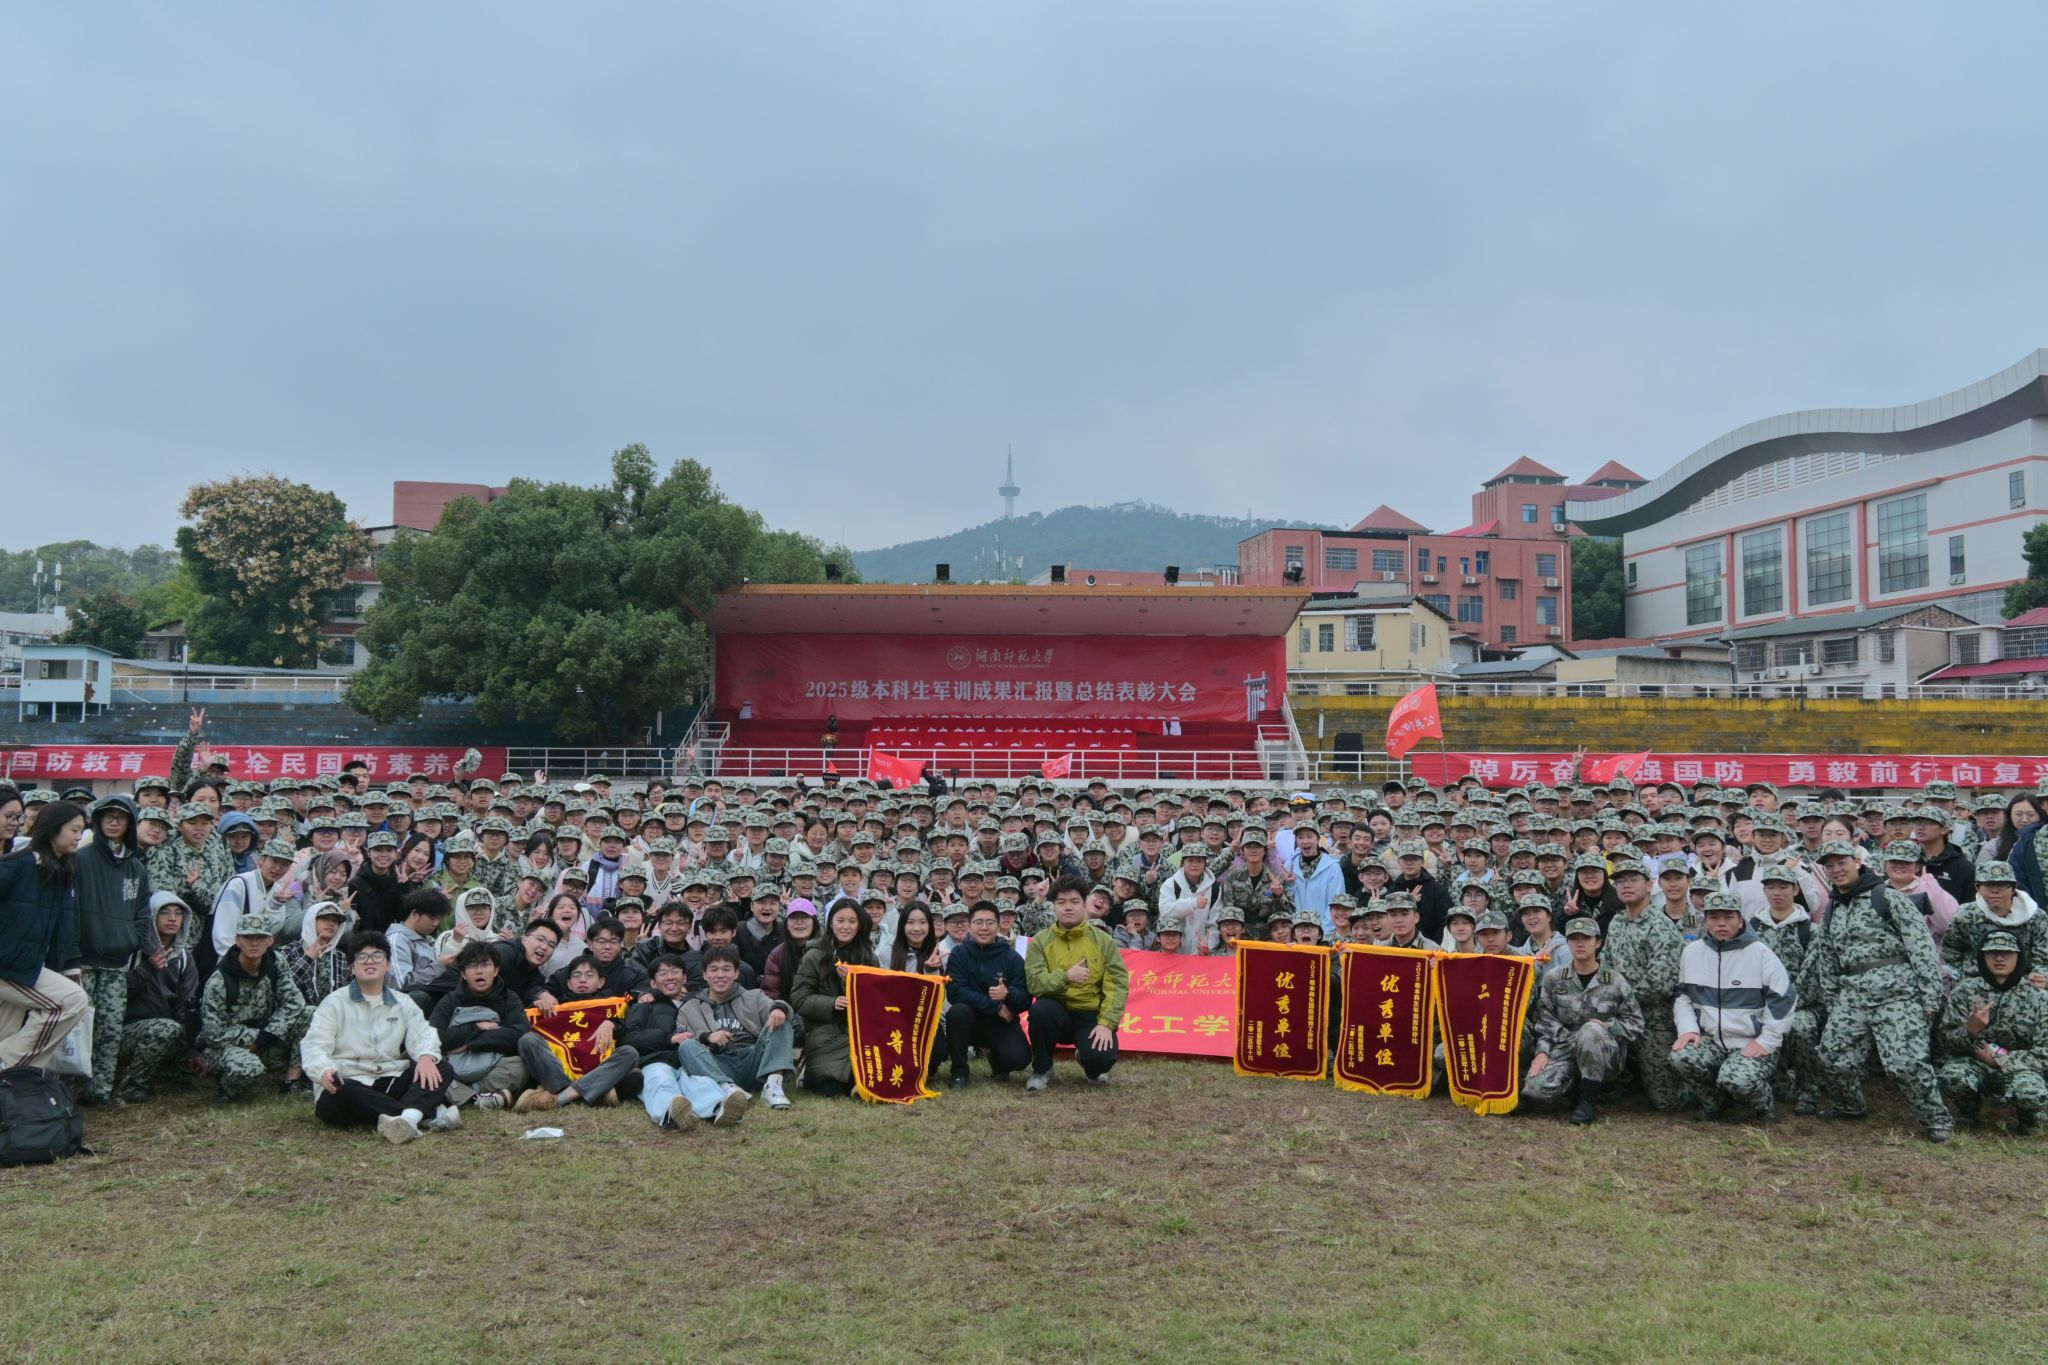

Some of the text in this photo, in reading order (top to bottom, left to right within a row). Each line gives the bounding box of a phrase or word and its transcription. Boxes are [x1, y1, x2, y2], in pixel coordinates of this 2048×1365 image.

[806, 679, 1197, 702] 2025级本科生军训成果汇报暨总结表彰大会
[0, 751, 146, 774] 国防教育
[1468, 759, 1744, 782] 踔厉奋强国防
[1127, 970, 1233, 989] 南师范大
[1146, 985, 1190, 996] NORMAL
[1273, 971, 1295, 1059] 优秀单位
[1375, 974, 1400, 1066] 优秀单位
[885, 1006, 904, 1088] 一等奖
